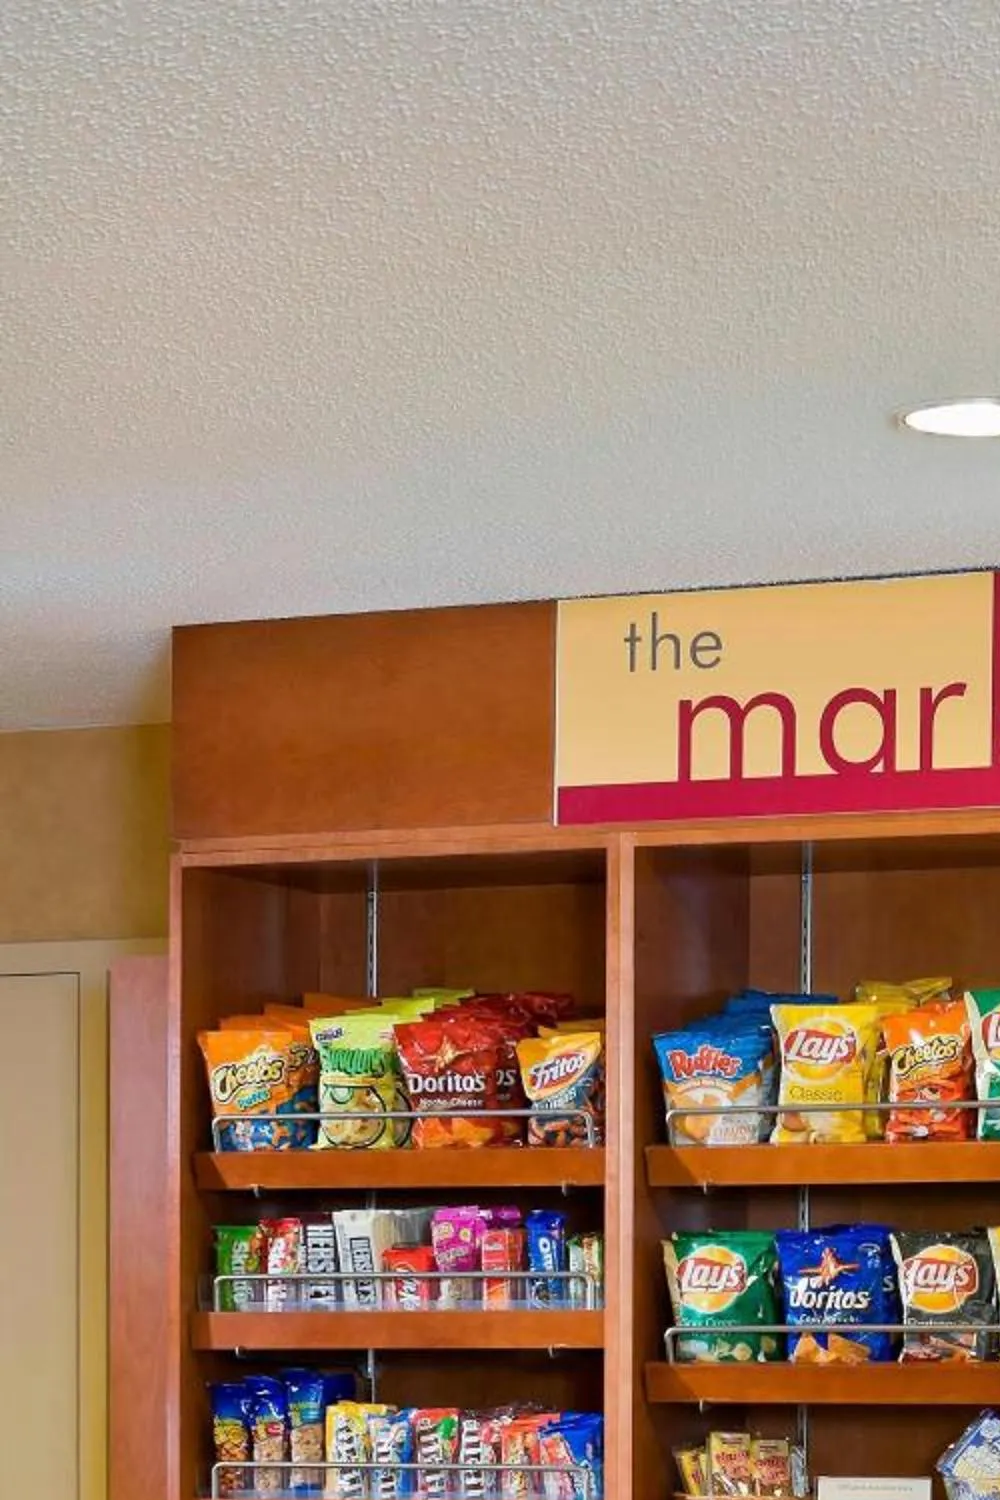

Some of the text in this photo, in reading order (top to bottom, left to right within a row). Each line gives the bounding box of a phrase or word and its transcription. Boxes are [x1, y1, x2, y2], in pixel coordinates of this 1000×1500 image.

[623, 611, 723, 673] the
[214, 1057, 284, 1100] Cheetos
[531, 1053, 586, 1089] Fritos
[669, 1045, 742, 1078] Ruffles
[407, 1071, 486, 1094] Doritos
[788, 1086, 843, 1101] Classic
[350, 1238, 375, 1304] HERSEY'S
[788, 1283, 870, 1309] Doritos
